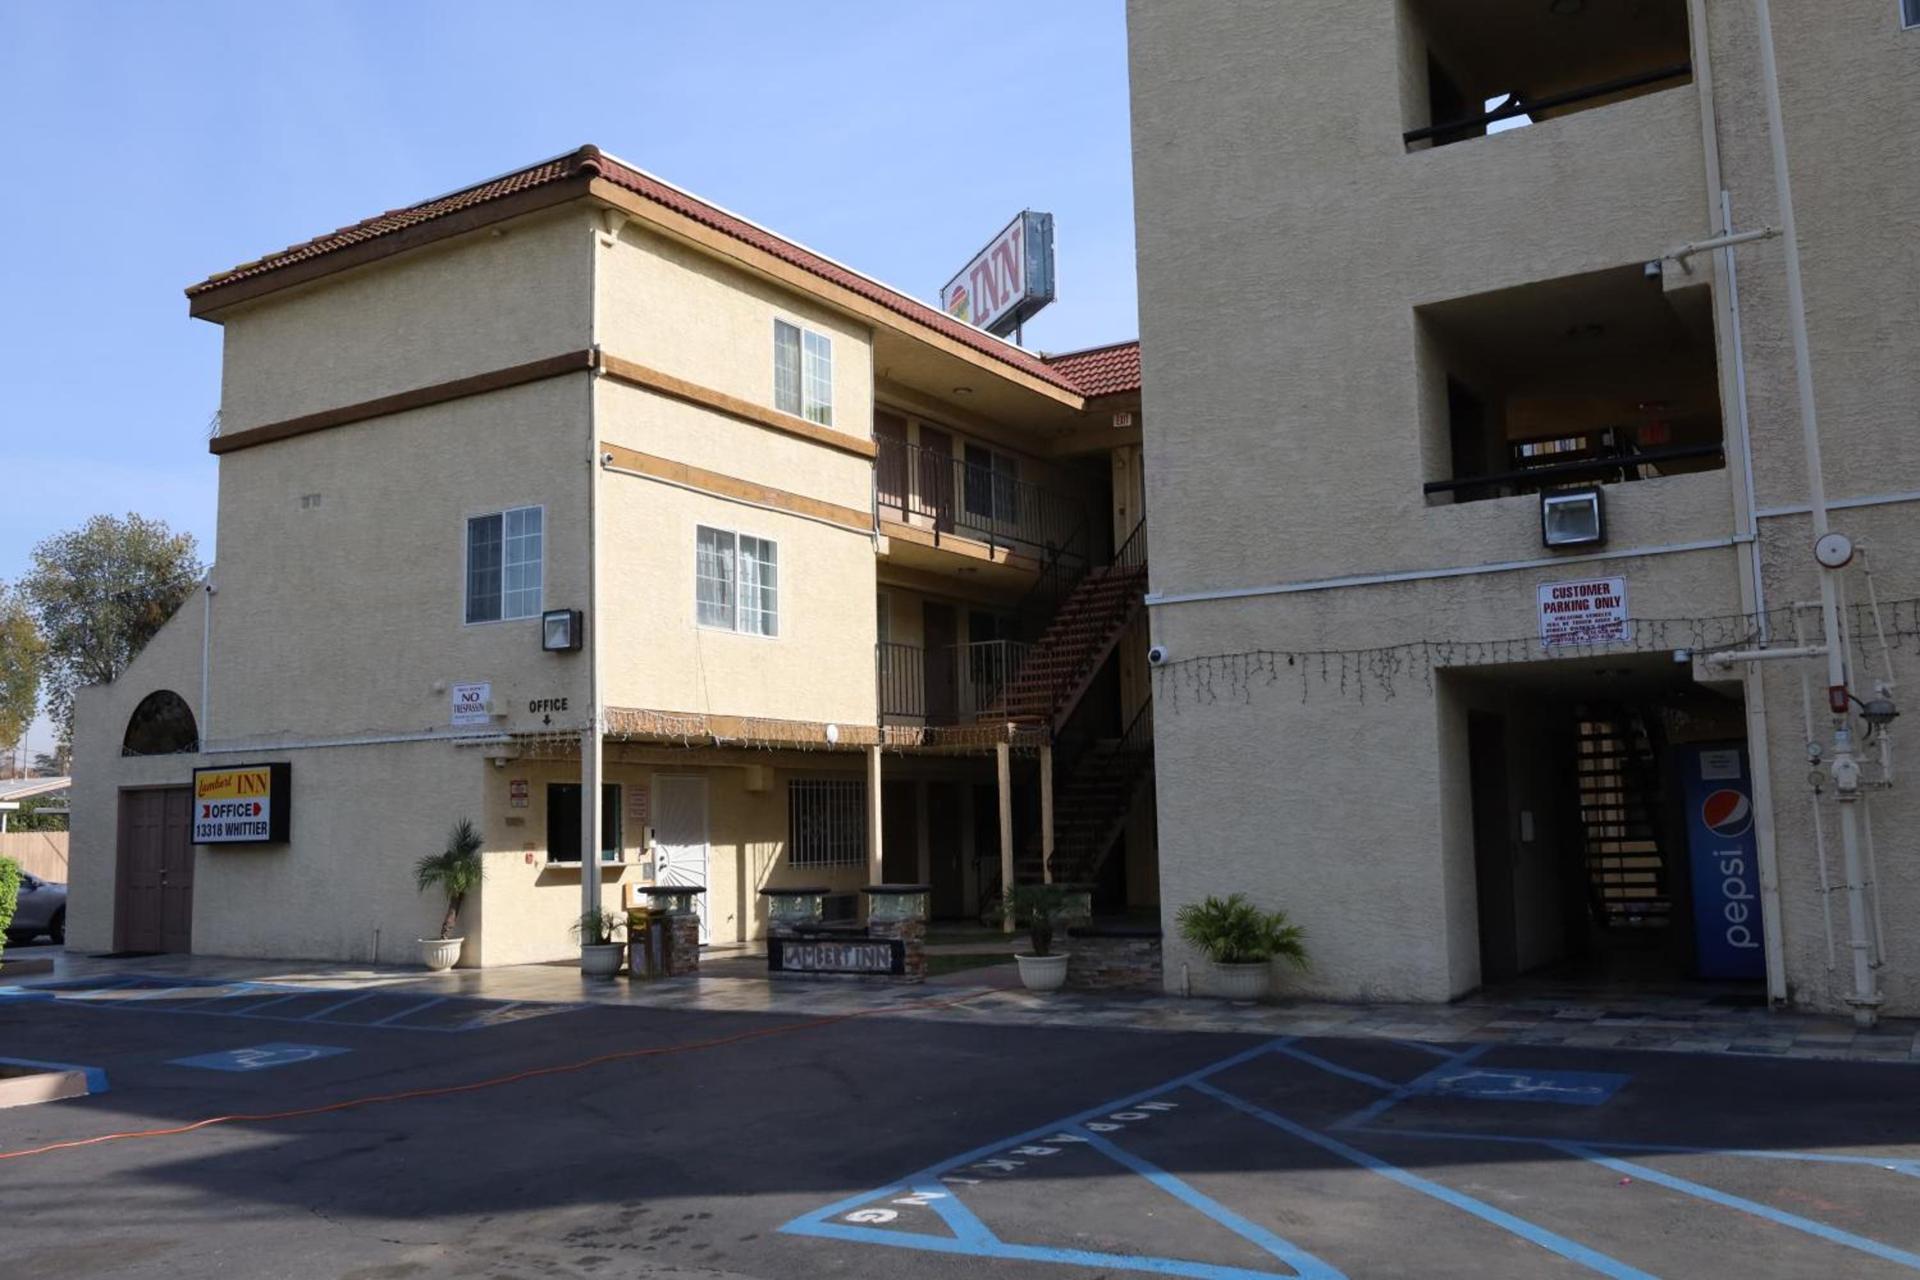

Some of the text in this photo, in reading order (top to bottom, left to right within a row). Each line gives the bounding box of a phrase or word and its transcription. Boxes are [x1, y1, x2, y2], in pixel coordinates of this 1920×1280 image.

[970, 226, 1021, 328] INN
[1552, 583, 1611, 599] CUSTOMER
[1543, 596, 1621, 614] PARKING ONLY
[461, 692, 480, 702] NO
[529, 698, 568, 713] OFFICE
[198, 773, 268, 797] Lambert INN
[211, 803, 252, 818] OFFICE
[225, 821, 268, 836] WHITTIER
[1713, 850, 1760, 948] pepsi
[784, 944, 890, 970] LAMBERT INN
